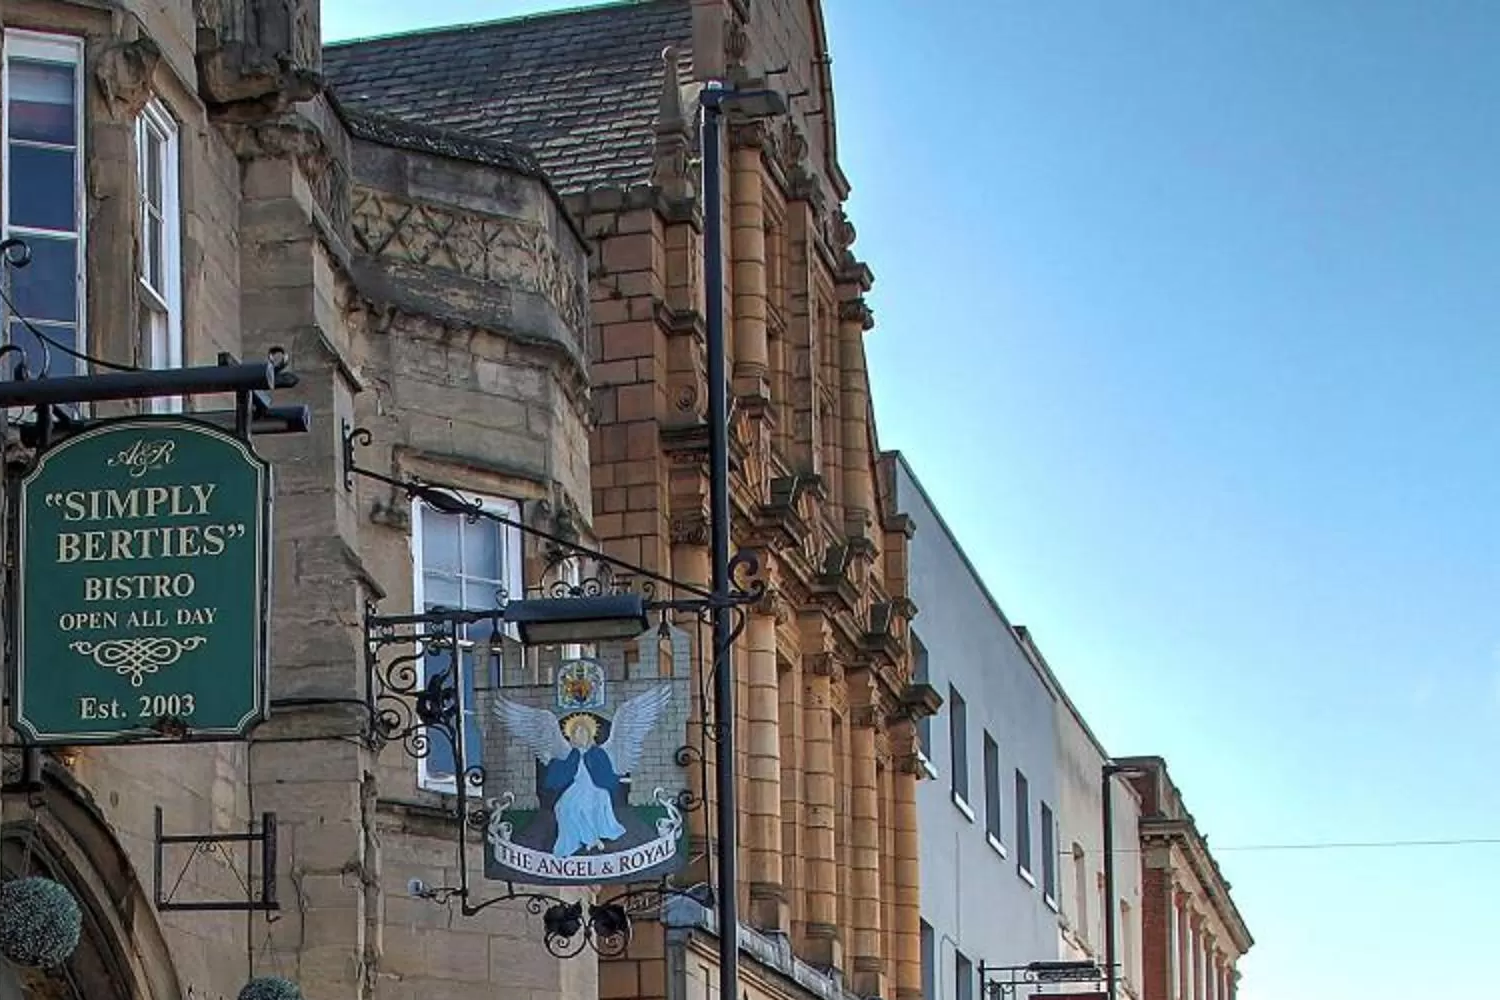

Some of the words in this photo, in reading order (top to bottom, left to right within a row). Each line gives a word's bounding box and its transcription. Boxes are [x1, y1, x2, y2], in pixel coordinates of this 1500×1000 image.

[84, 573, 196, 601] BISTRO
[59, 612, 118, 631] OPEN
[126, 610, 168, 627] ALL
[176, 607, 217, 625] DAY
[80, 697, 128, 719] Est.
[139, 694, 195, 718] 2003
[502, 848, 532, 869] THE
[537, 858, 596, 877] ANGEL
[602, 861, 614, 873] &
[619, 840, 675, 873] ROYAL
